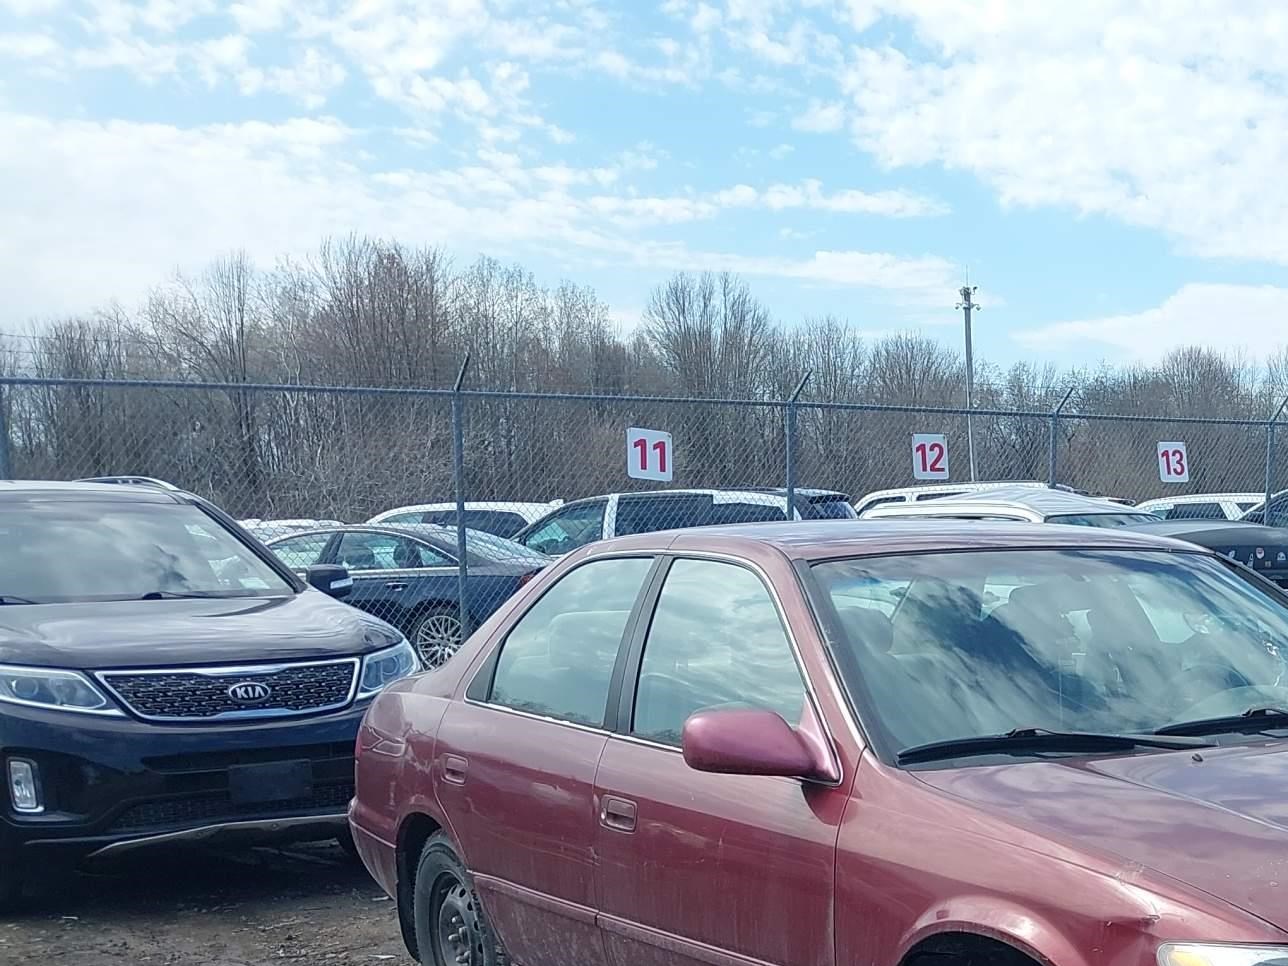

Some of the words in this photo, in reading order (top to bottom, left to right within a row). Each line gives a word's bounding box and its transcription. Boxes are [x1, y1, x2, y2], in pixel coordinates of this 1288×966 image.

[633, 438, 667, 473] 11
[915, 442, 946, 473] 12
[1161, 449, 1185, 475] 13
[235, 685, 266, 699] KIA
